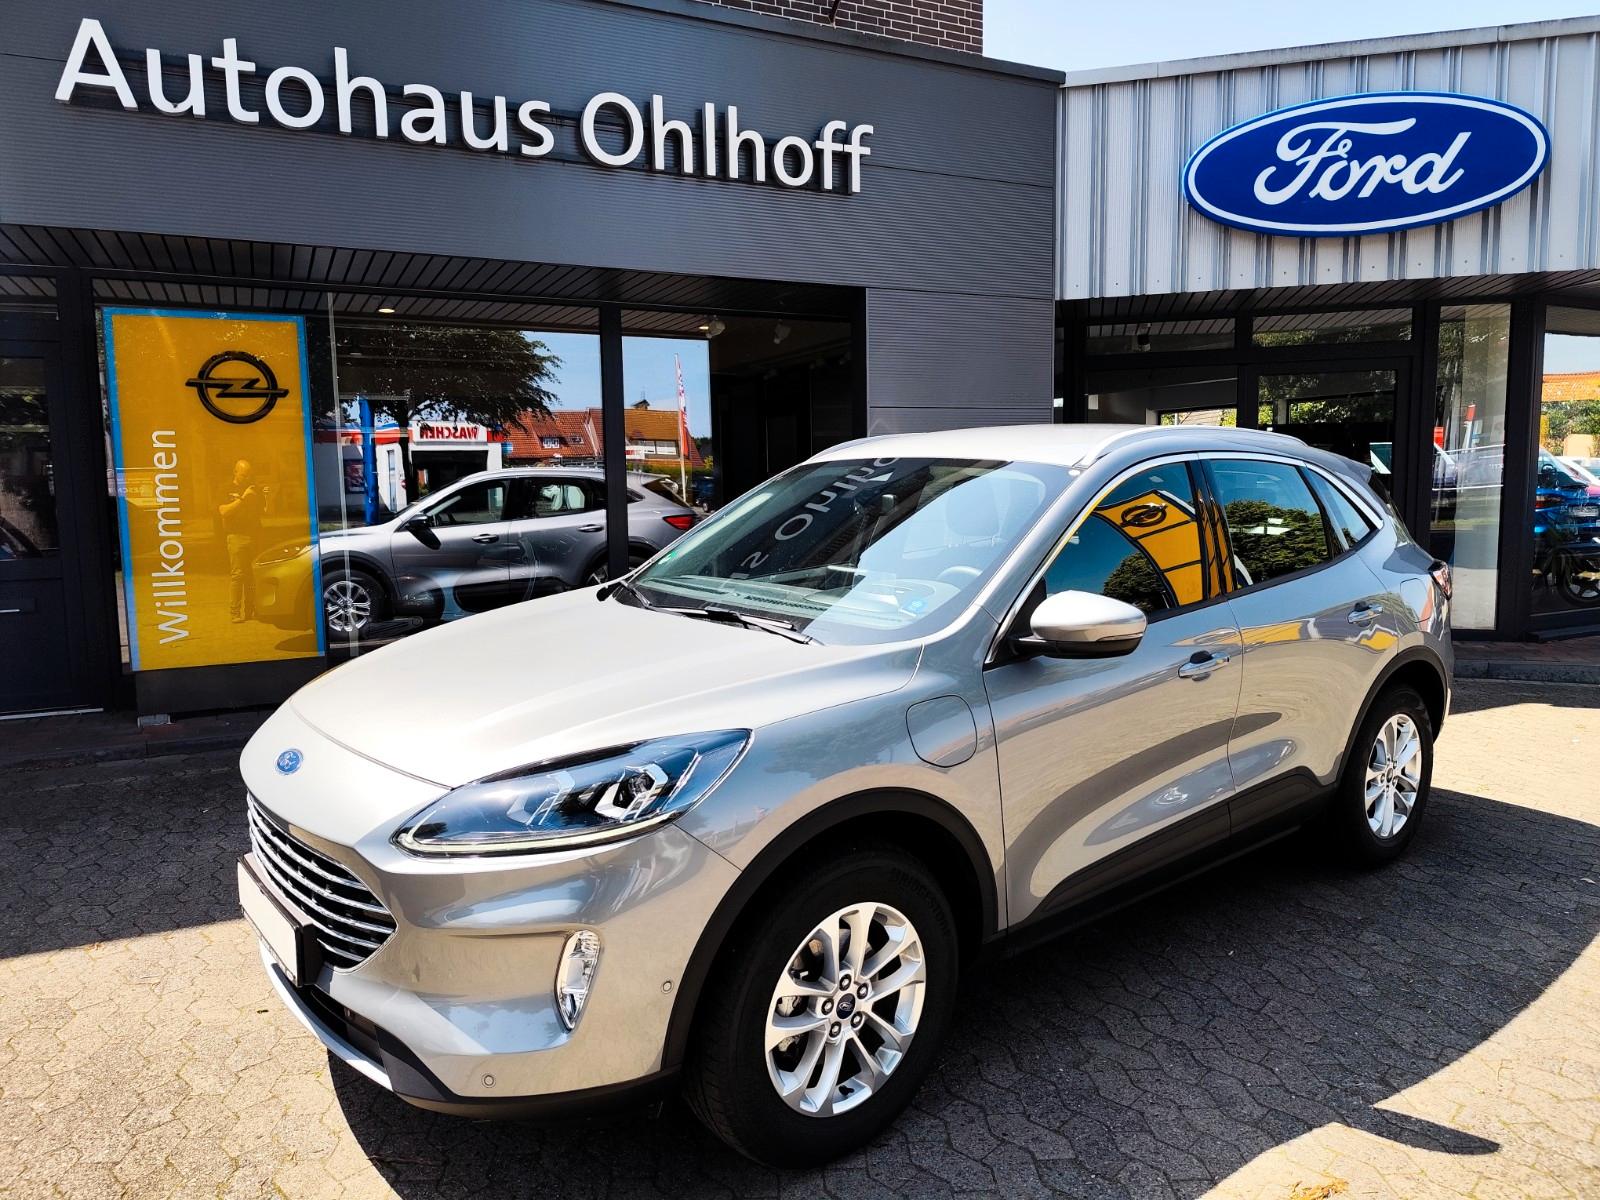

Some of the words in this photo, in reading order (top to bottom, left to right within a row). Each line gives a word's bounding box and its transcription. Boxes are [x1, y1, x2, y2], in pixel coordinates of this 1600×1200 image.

[55, 18, 554, 156] Autohaus
[582, 92, 874, 193] Ohlhoff
[1253, 117, 1472, 206] Ford
[151, 429, 190, 645] Willkommen
